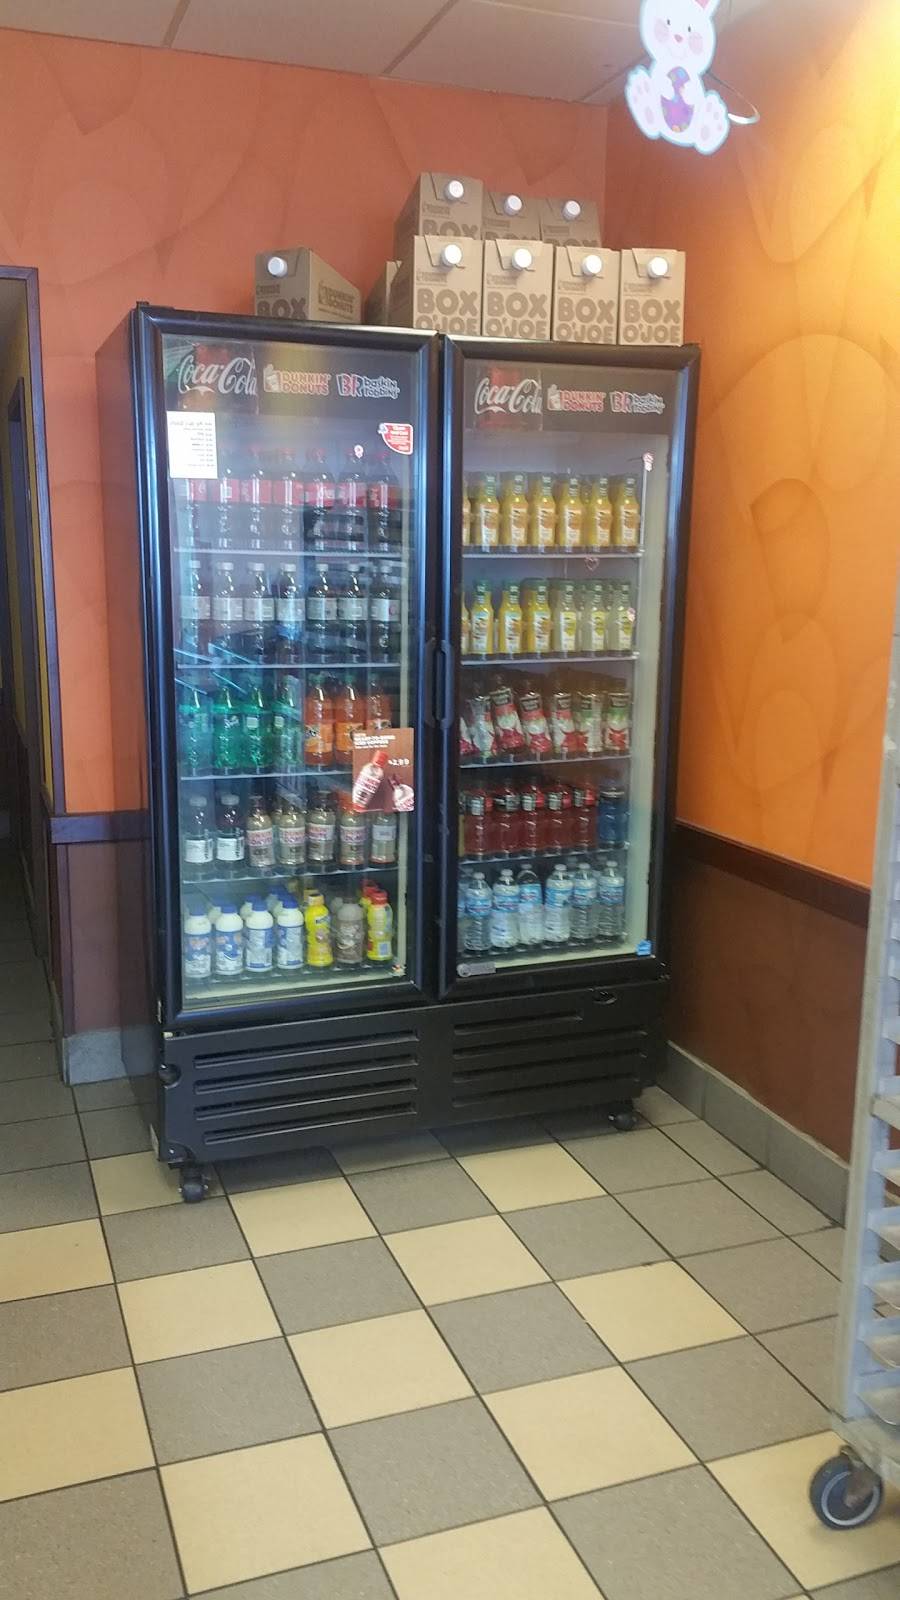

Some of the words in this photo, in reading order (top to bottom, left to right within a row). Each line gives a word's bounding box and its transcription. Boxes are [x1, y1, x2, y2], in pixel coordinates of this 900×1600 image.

[257, 298, 306, 319] BOX
[417, 288, 478, 316] BOX
[487, 291, 547, 319] BOX
[558, 297, 615, 324] BOX
[624, 299, 680, 324] BOX
[486, 317, 547, 338] O'JOE
[556, 321, 613, 343] O'JOE
[623, 323, 680, 343] O'JOE
[178, 354, 258, 396] Coca-Cola
[281, 371, 331, 384] DUNKIN'
[336, 373, 363, 397] BR
[282, 383, 329, 396] DONUTS
[474, 377, 544, 414] Coca-Cola
